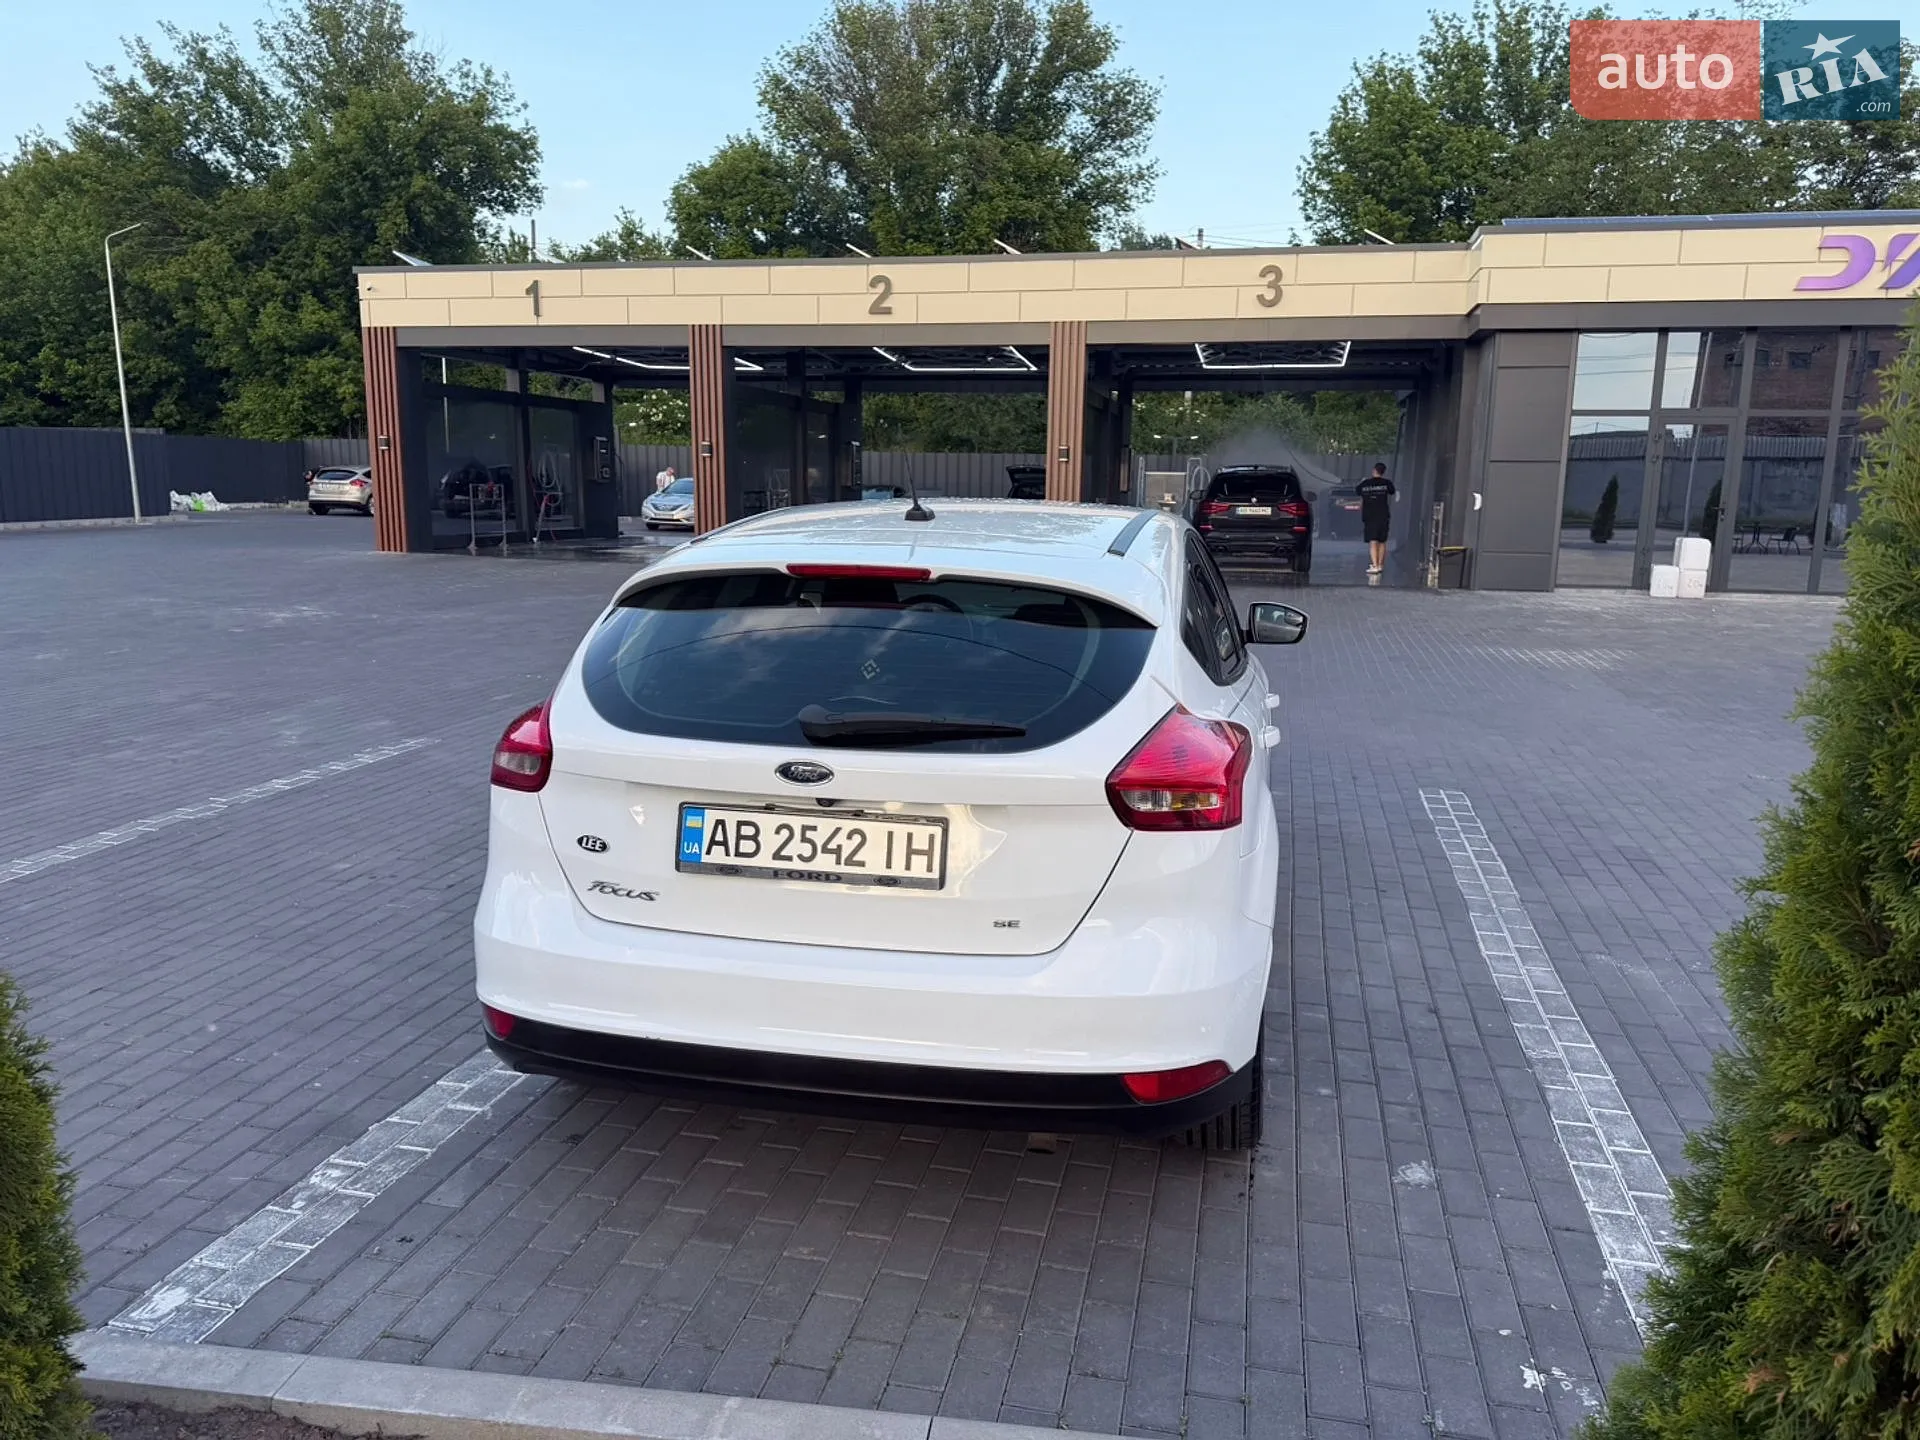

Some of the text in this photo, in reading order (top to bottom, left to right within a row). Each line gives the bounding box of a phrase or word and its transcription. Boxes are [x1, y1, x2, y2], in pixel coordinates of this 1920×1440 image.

[525, 279, 541, 317] 1
[868, 274, 893, 315] 2
[1256, 264, 1283, 308] 3
[582, 836, 604, 851] LEE
[684, 841, 700, 854] UA
[705, 818, 935, 873] AB 2542 IH
[773, 870, 842, 882] FORD
[992, 919, 1021, 929] SE
